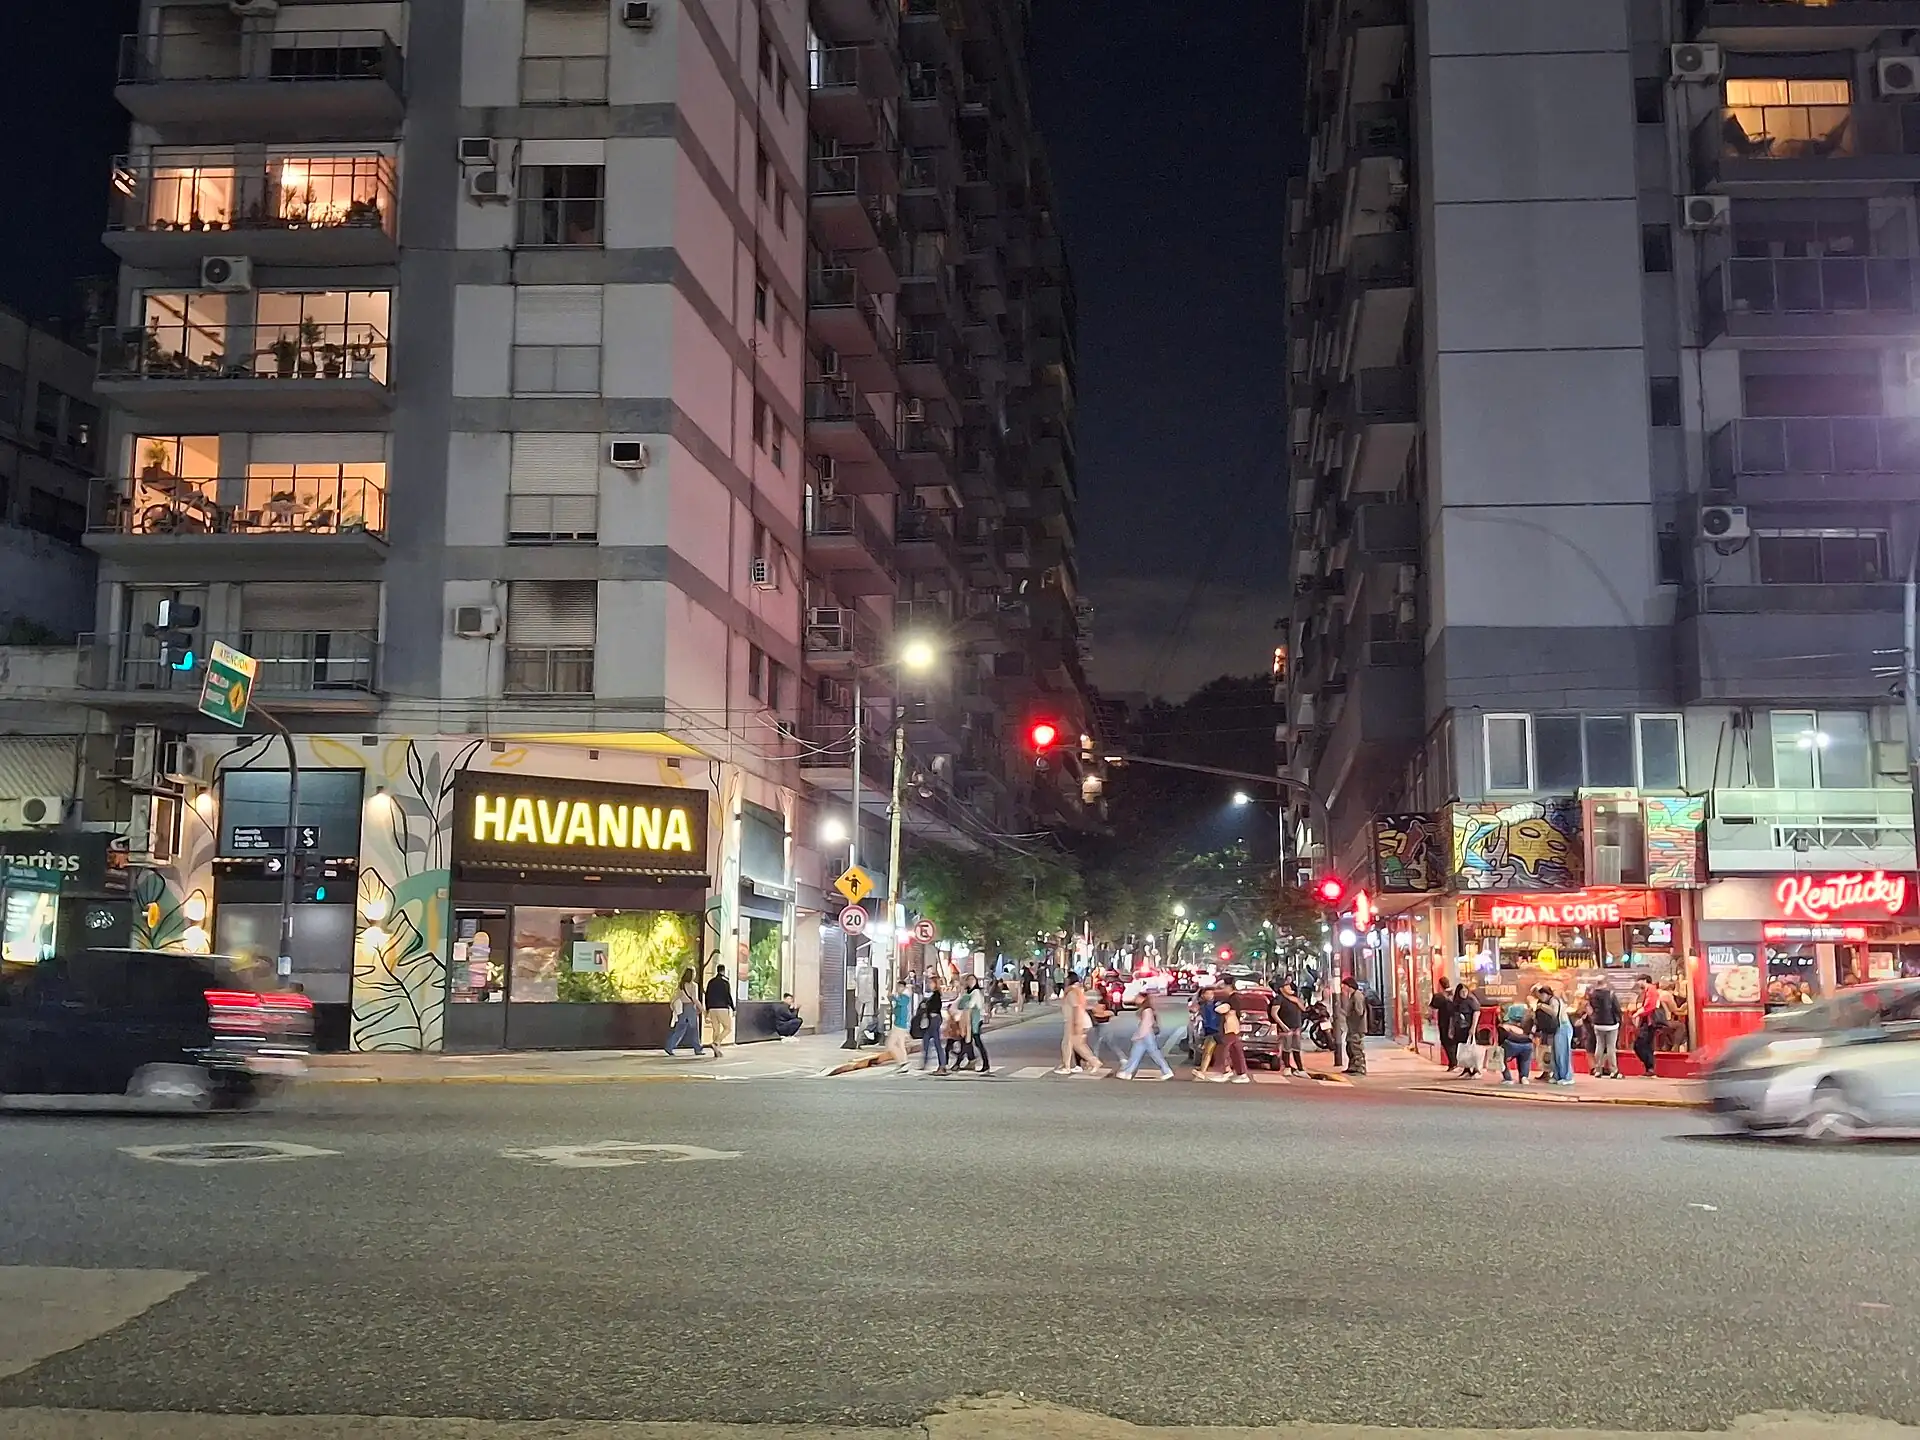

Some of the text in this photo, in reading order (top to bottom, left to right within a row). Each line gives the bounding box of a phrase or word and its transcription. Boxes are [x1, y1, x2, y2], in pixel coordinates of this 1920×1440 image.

[474, 795, 692, 852] HAVANNA
[1777, 871, 1906, 920] Kentucky
[846, 914, 862, 927] 20
[1491, 903, 1620, 923] PIZZA AL CORTE
[1708, 953, 1735, 965] MUZZA
